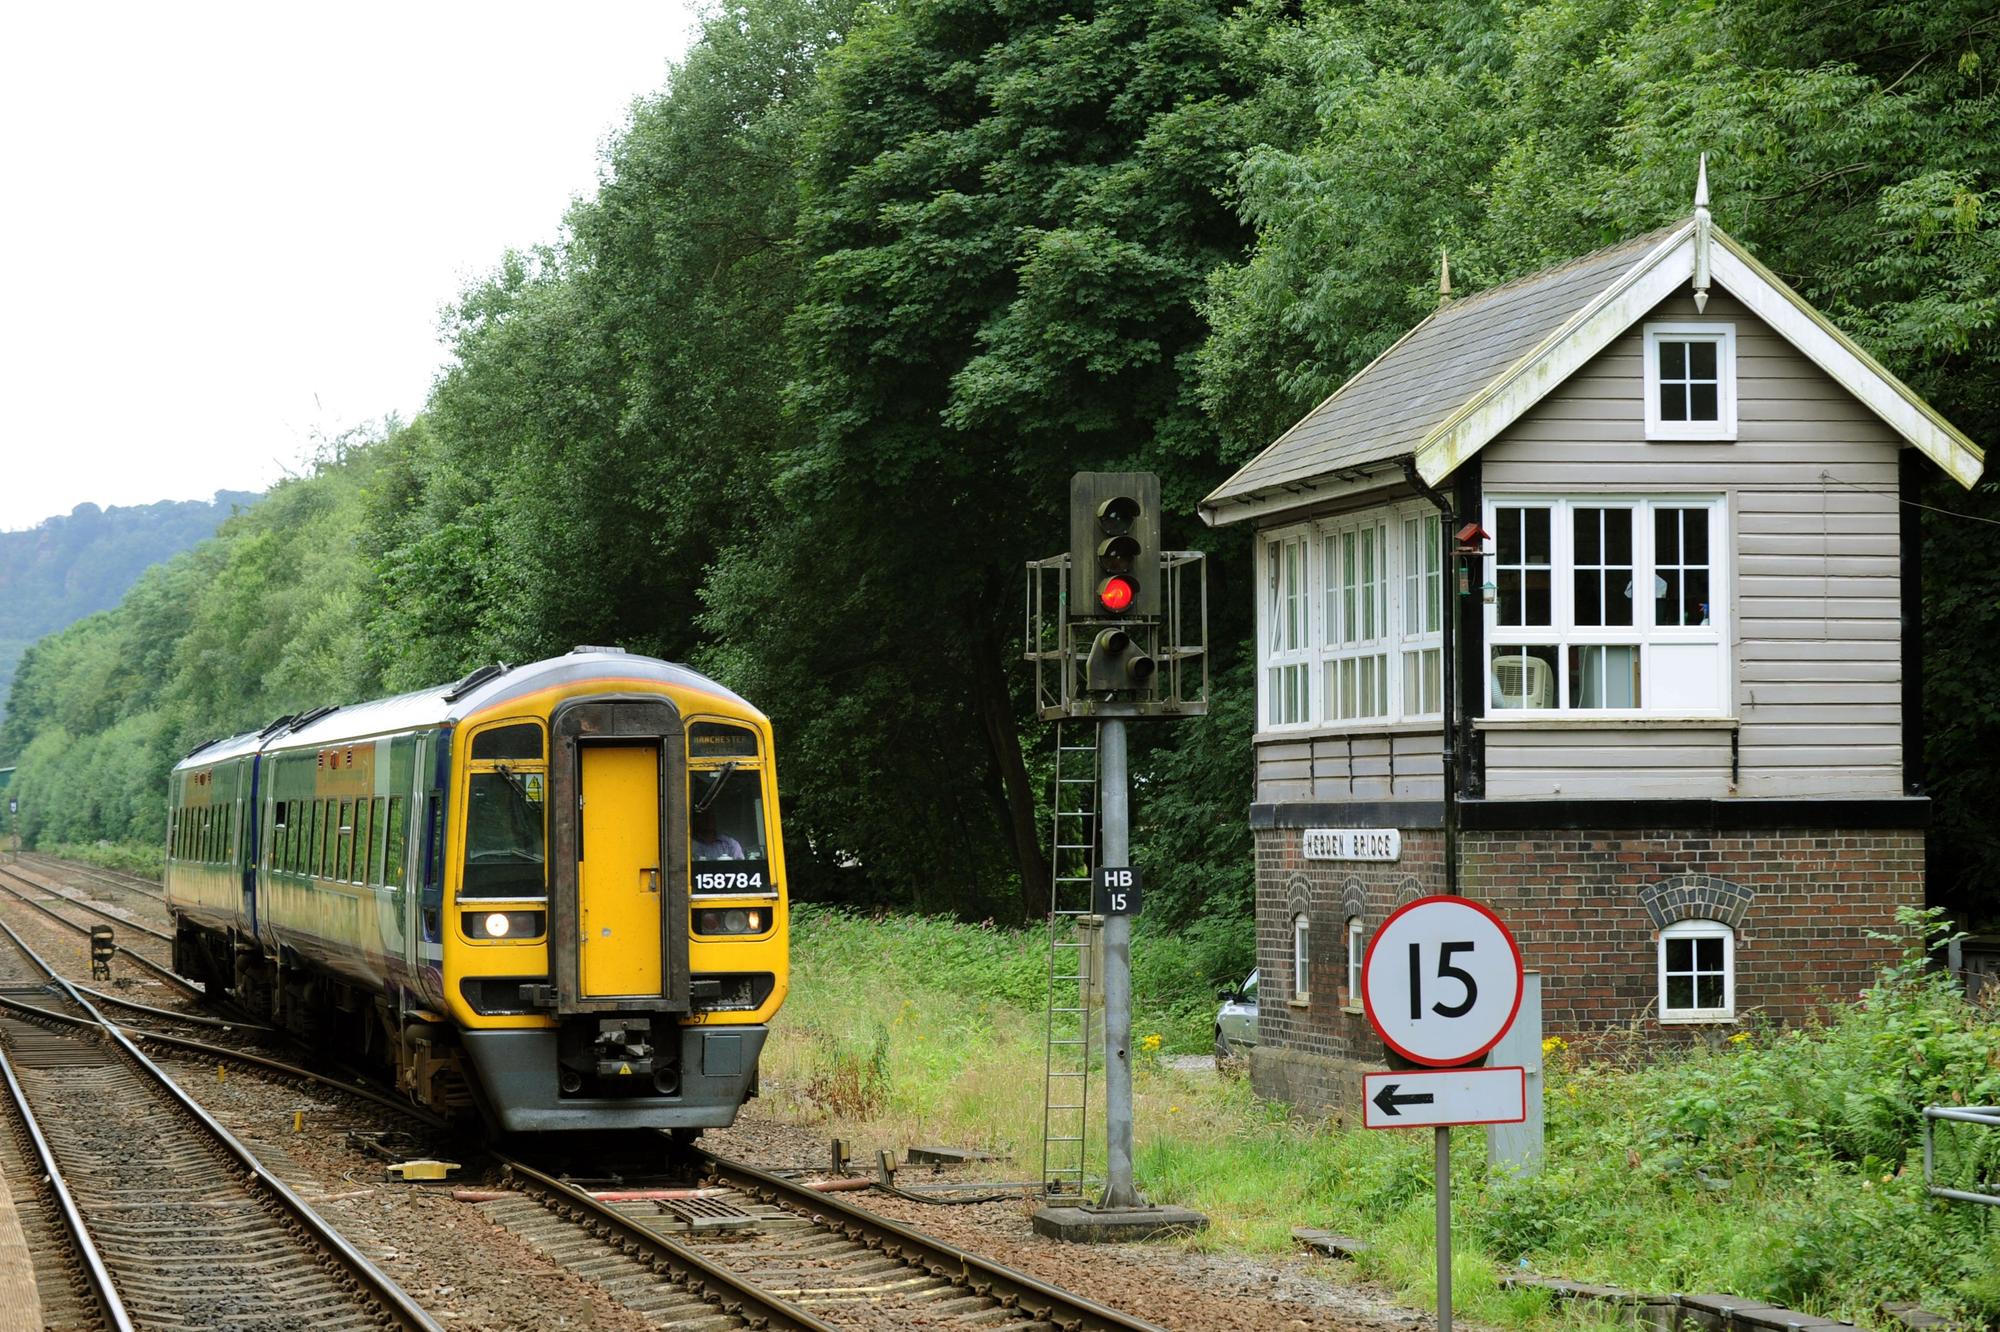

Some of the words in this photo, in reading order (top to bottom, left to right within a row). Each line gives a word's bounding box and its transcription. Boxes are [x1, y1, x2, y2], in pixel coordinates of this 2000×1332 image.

[1307, 835, 1344, 856] HEBDEN
[1353, 835, 1391, 857] BRIDGE
[696, 872, 762, 889] 158784
[1105, 871, 1133, 887] HB
[1112, 893, 1127, 911] 15
[1409, 941, 1478, 1020] 15
